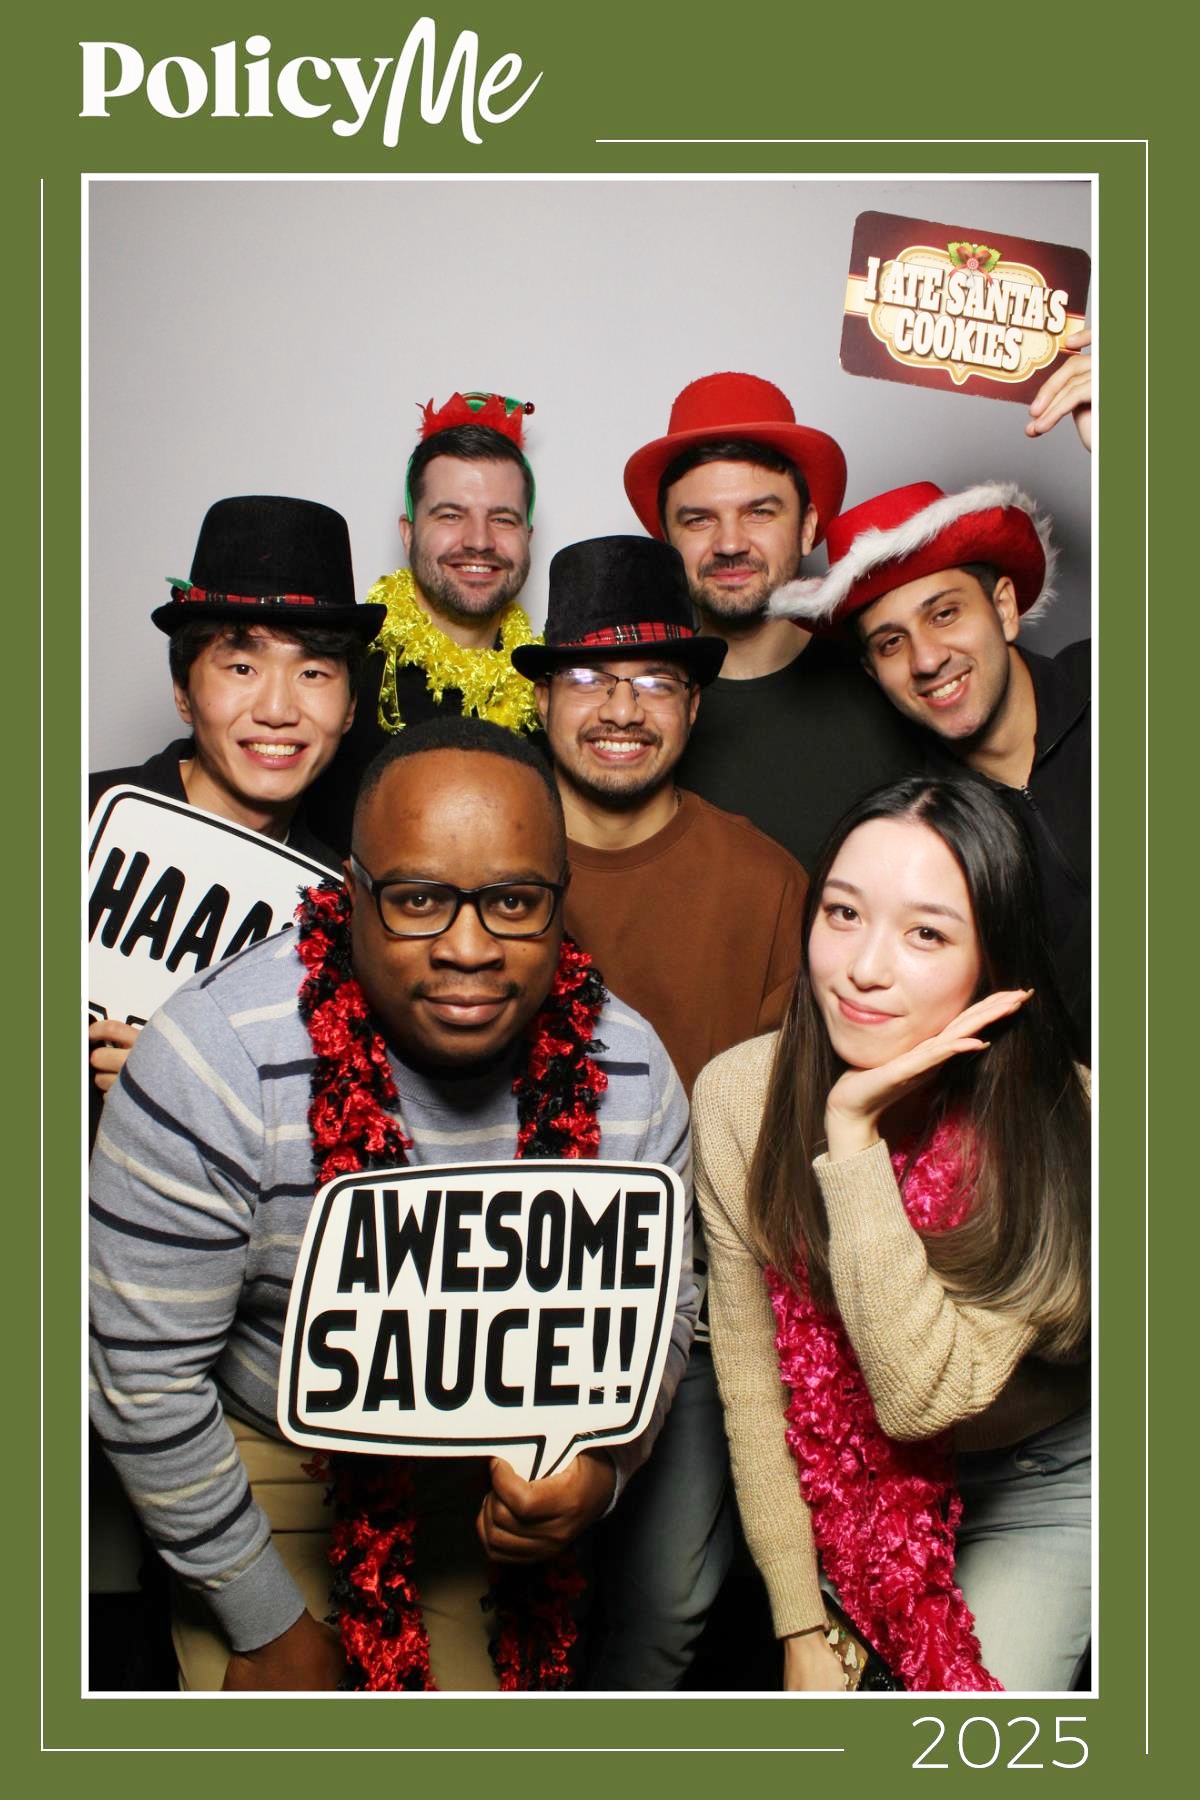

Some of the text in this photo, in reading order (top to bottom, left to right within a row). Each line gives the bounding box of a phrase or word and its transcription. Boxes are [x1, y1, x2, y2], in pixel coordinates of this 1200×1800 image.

[864, 256, 1069, 335] I ATE SANTA'S
[893, 308, 1024, 372] COOKIES
[89, 847, 294, 974] HAA
[337, 1188, 661, 1297] AWESOME
[305, 1307, 638, 1413] SAUCE!!
